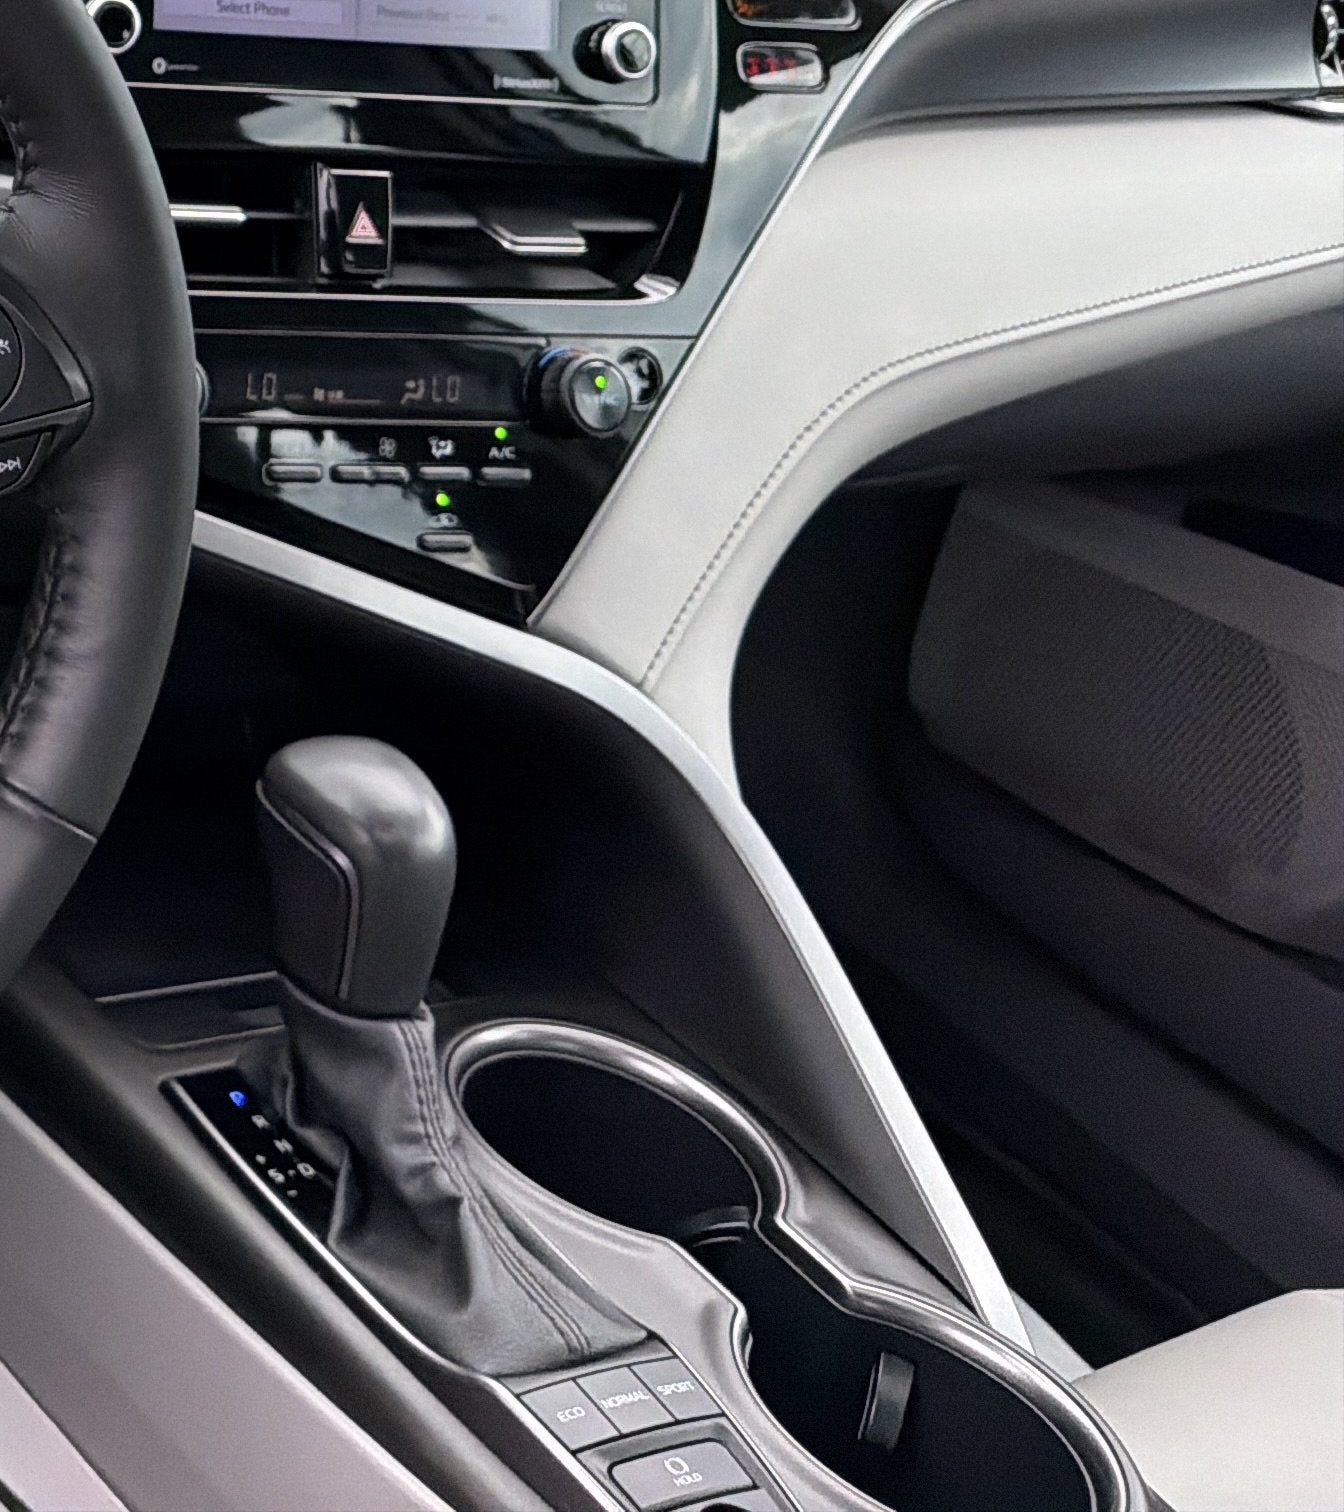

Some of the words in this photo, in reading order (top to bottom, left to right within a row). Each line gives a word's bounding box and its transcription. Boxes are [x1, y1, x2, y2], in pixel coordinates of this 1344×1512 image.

[217, 0, 251, 15] Select
[254, 0, 290, 17] Phone
[488, 446, 516, 460] A/C
[656, 1380, 695, 1396] SPORT
[599, 1390, 650, 1409] NORMAL
[557, 1406, 586, 1422] ECO
[673, 1472, 703, 1486] HOLD
